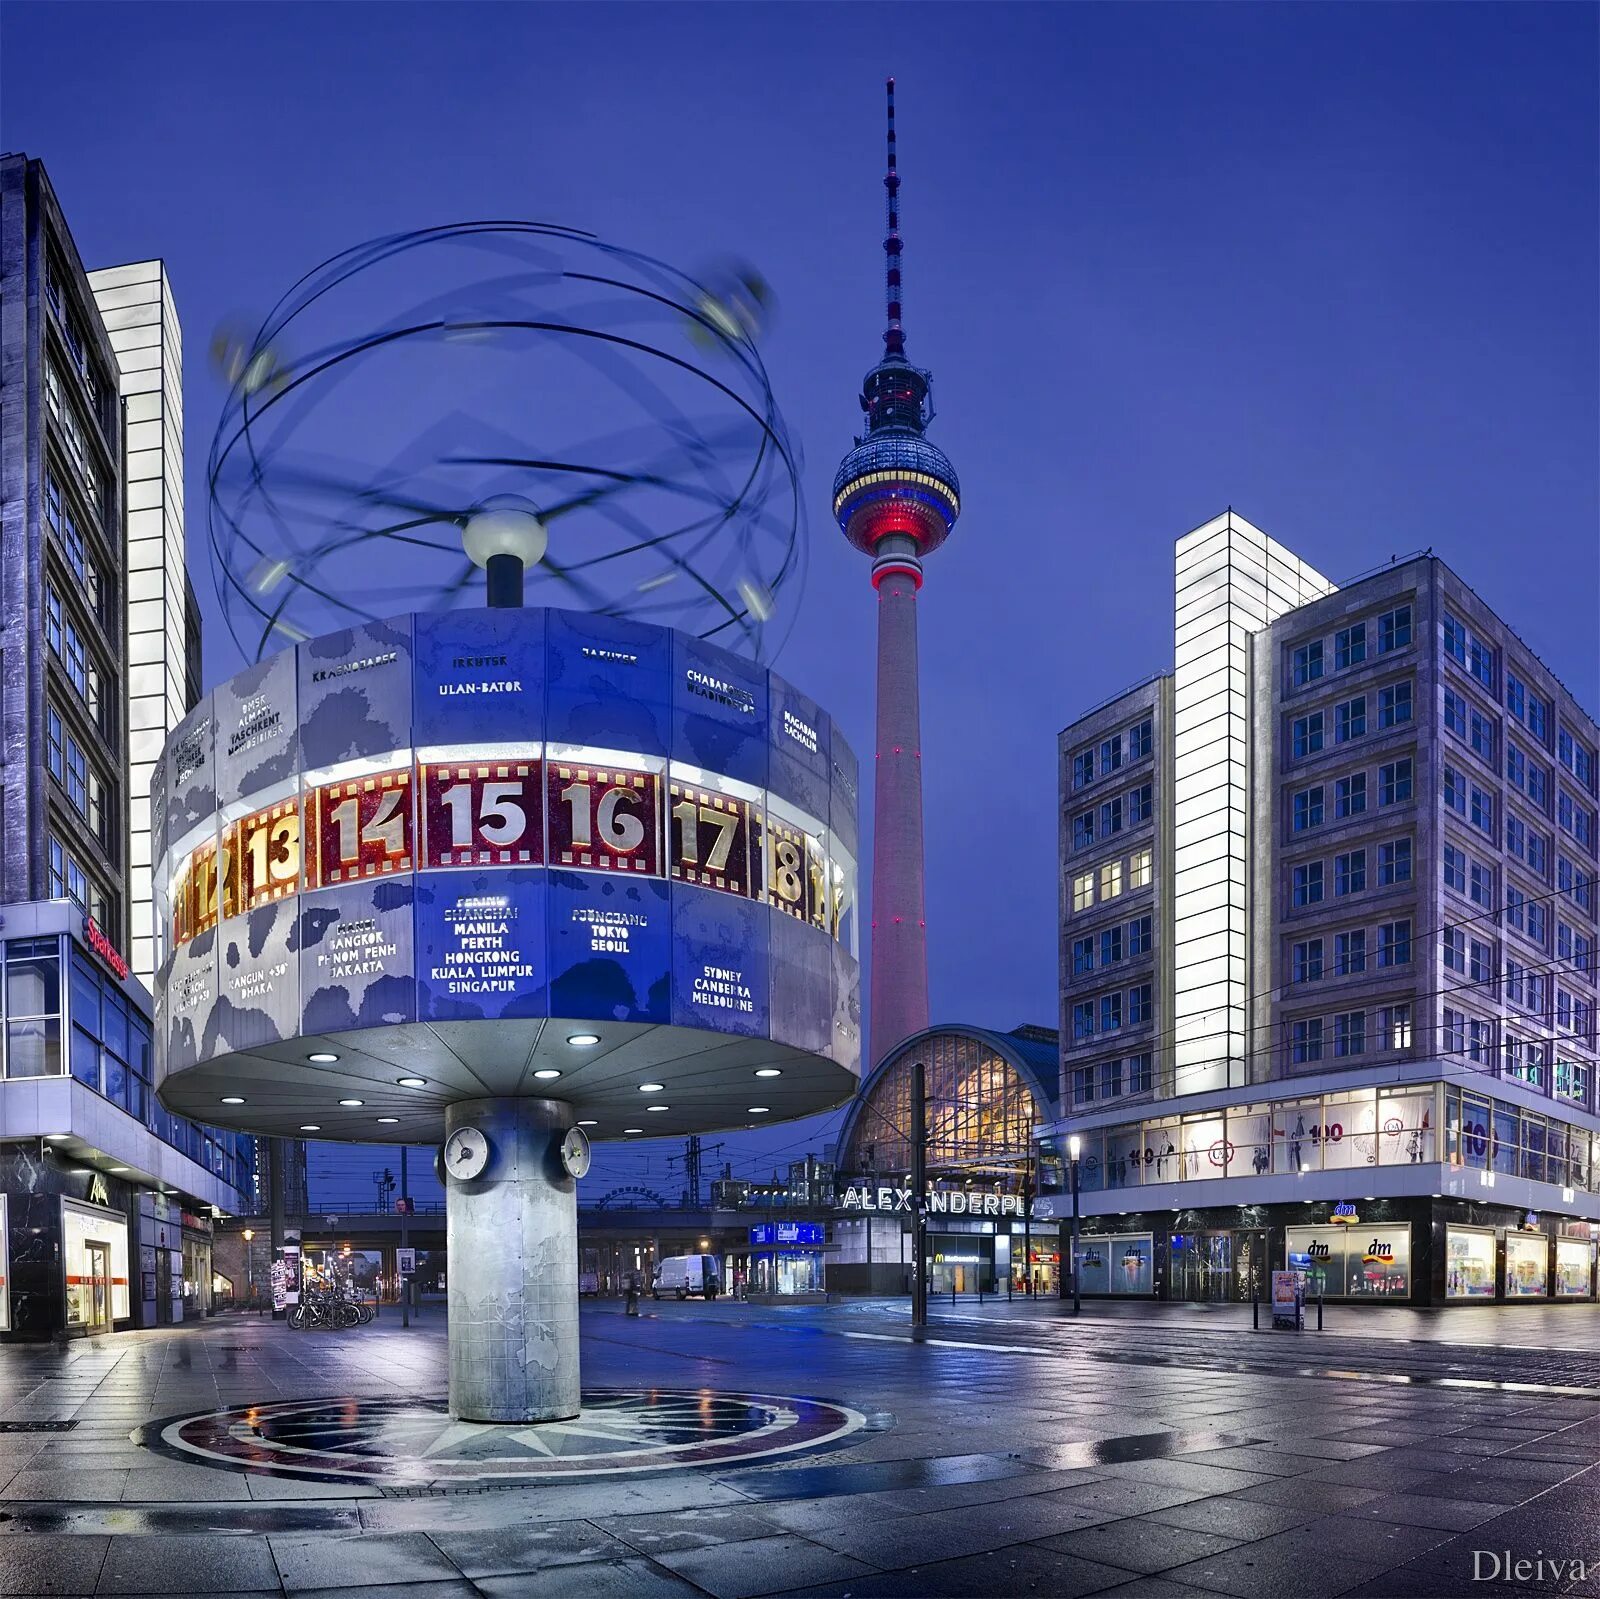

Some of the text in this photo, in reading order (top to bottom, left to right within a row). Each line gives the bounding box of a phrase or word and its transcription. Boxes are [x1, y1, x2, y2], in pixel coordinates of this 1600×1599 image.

[439, 682, 521, 695] ULAN-BATOR
[231, 711, 280, 745] TASCHKENT
[784, 722, 817, 753] SACHALIN
[441, 782, 527, 847] 15
[561, 783, 645, 851] 16
[330, 789, 405, 861] 14
[672, 801, 740, 870] 17
[246, 815, 300, 890] 13
[757, 830, 802, 902] 18
[197, 848, 232, 920] 12
[454, 922, 509, 936] MANILA
[591, 925, 629, 939] TOKYO
[461, 936, 503, 949] PERTH
[591, 939, 630, 953] SEOUL
[364, 944, 397, 959] PENH
[445, 951, 520, 965] HONGKONG
[330, 961, 385, 978] JAKARTA
[431, 965, 533, 980] KUALA LUMPUR
[704, 965, 742, 982] SYDNEY
[241, 982, 274, 999] DHAKA
[448, 980, 516, 993] SINGAPUR
[694, 979, 751, 998] CANBERRA
[693, 991, 754, 1012] MELBOURNE
[1310, 1123, 1344, 1144] 100
[1334, 1201, 1356, 1216] dm
[1308, 1239, 1329, 1256] dm
[1367, 1239, 1391, 1256] dm
